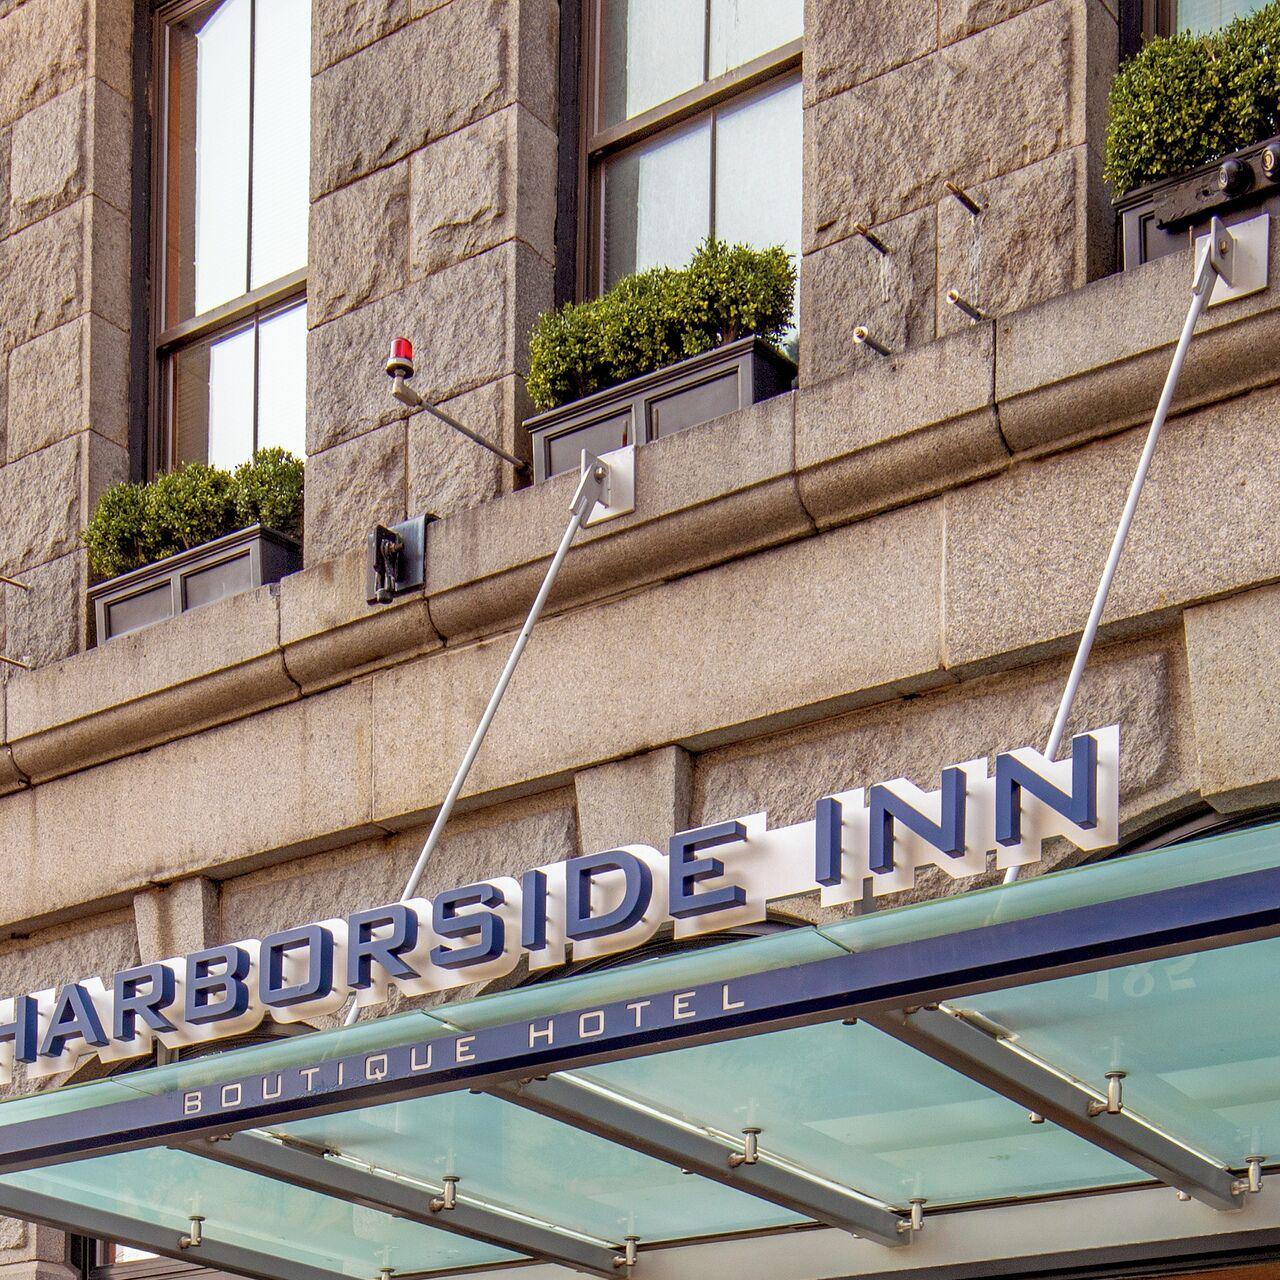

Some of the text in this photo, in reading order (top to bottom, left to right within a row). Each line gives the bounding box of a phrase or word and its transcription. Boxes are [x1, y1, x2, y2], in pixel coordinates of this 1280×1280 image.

[815, 733, 1098, 888] INN
[183, 984, 746, 1115] BOUTIQUE HOTEL
